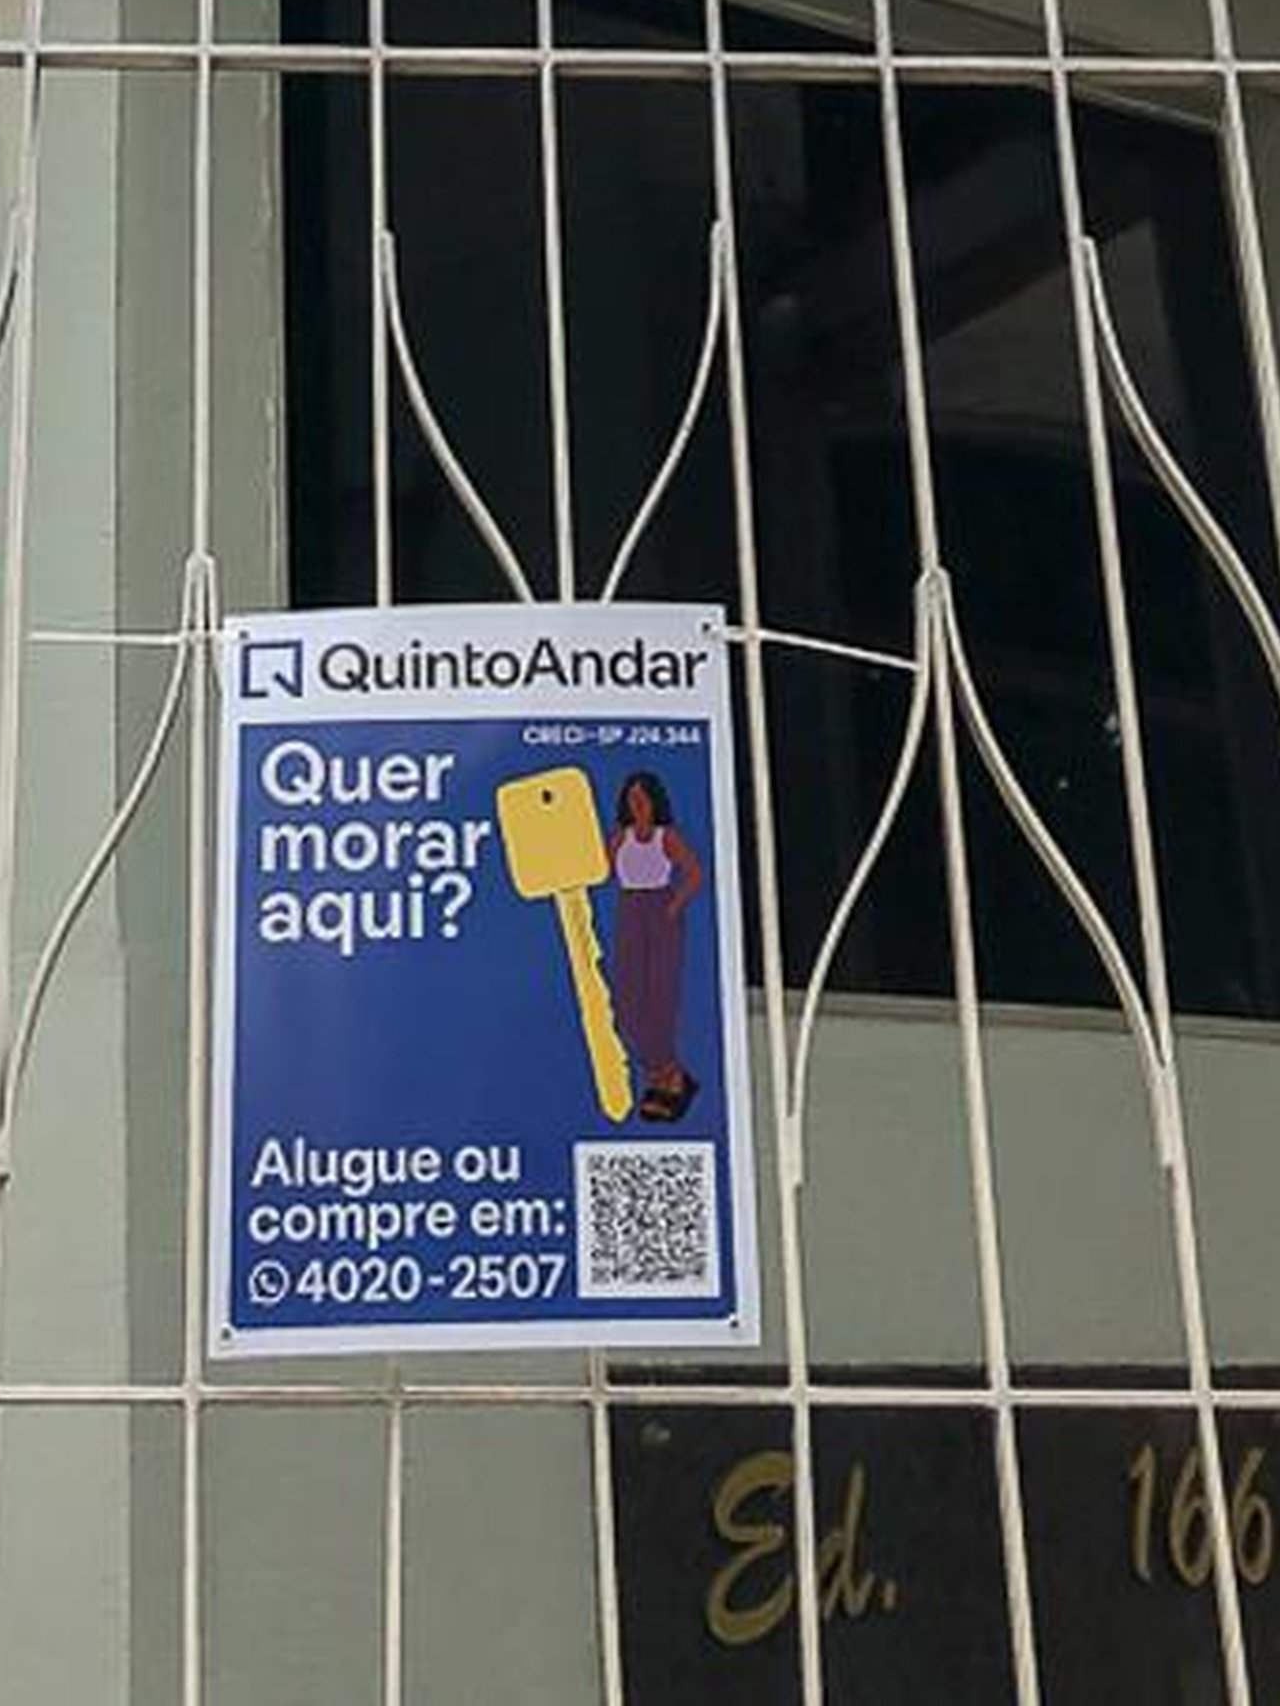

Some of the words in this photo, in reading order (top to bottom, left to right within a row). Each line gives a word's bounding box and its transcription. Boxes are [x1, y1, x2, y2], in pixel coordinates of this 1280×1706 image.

[320, 638, 708, 693] QuintoAndar
[260, 741, 454, 806] Quer
[260, 820, 491, 872] morar
[260, 874, 472, 955] aqui?
[250, 1139, 442, 1199] Alugue
[453, 1147, 521, 1181] ou
[248, 1202, 457, 1249] compre
[470, 1196, 568, 1236] em:
[294, 1255, 566, 1305] 4020-2507
[705, 1449, 898, 1645] Ed.
[1128, 1443, 1275, 1586] 166
